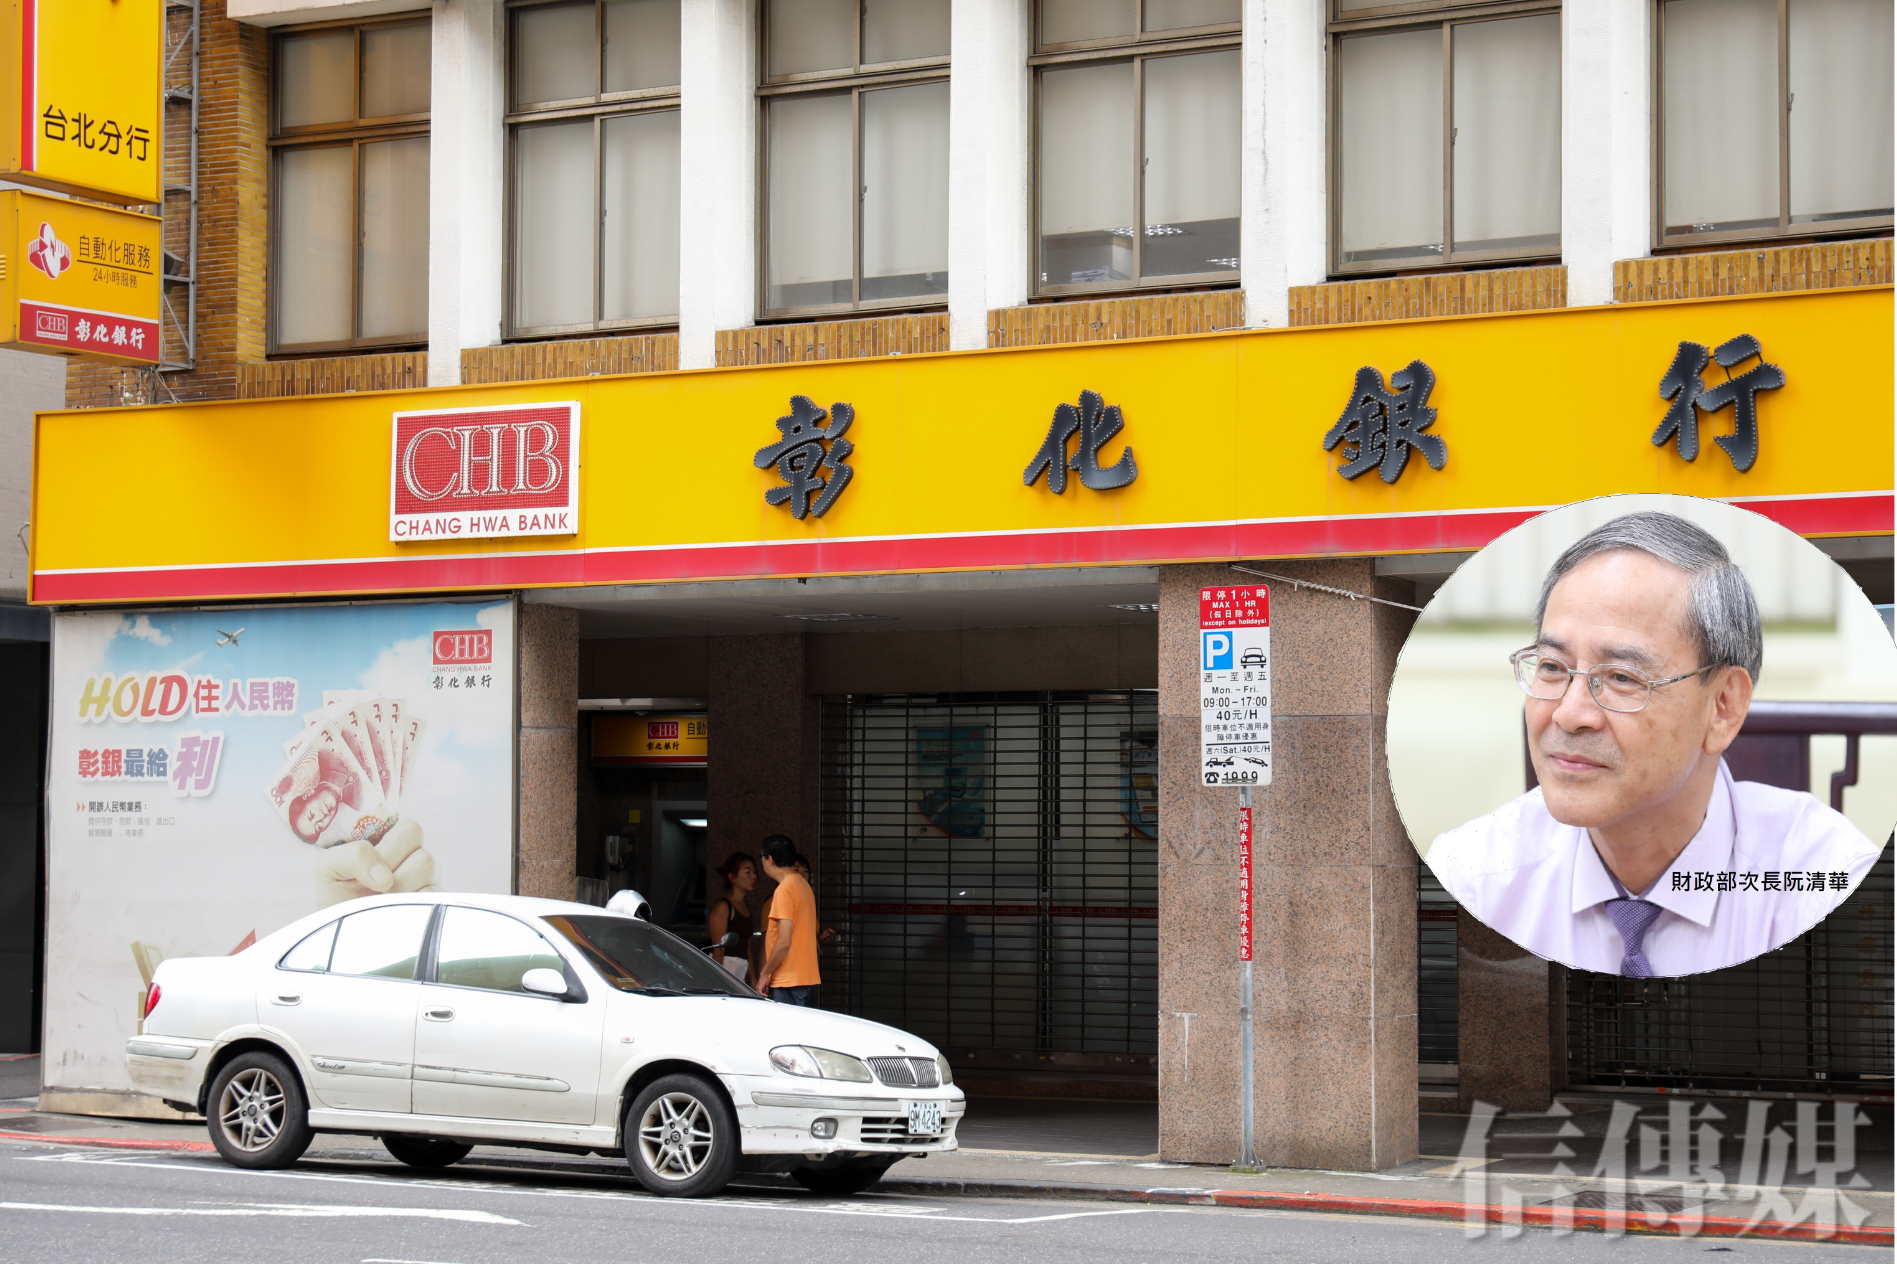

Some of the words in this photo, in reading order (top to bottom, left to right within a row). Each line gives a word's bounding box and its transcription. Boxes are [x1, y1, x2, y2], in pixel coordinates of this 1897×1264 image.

[43, 104, 150, 162] 台北分行
[79, 234, 151, 269] 自動化服務
[93, 267, 138, 289] 24小時服務
[38, 315, 66, 332] CHB
[75, 318, 146, 350] 彰化銀行
[754, 333, 1786, 520] 彰化銀行
[402, 420, 563, 501] CHB
[394, 517, 462, 536] CHANG
[470, 515, 511, 533] HWA
[518, 512, 569, 531] BANK
[1202, 588, 1267, 601] 限停1小時
[1209, 608, 1260, 619] (假日除外)
[435, 634, 490, 660] CHB
[1206, 634, 1230, 668] P
[432, 674, 492, 690] 彰化銀行
[1203, 671, 1267, 683] 週一至週五
[1216, 709, 1258, 721] 40元/H
[648, 723, 677, 737] CHB
[687, 721, 708, 736] 自動
[1205, 722, 1269, 732] 限時車位不適用身
[646, 742, 680, 750] 彰化銀行
